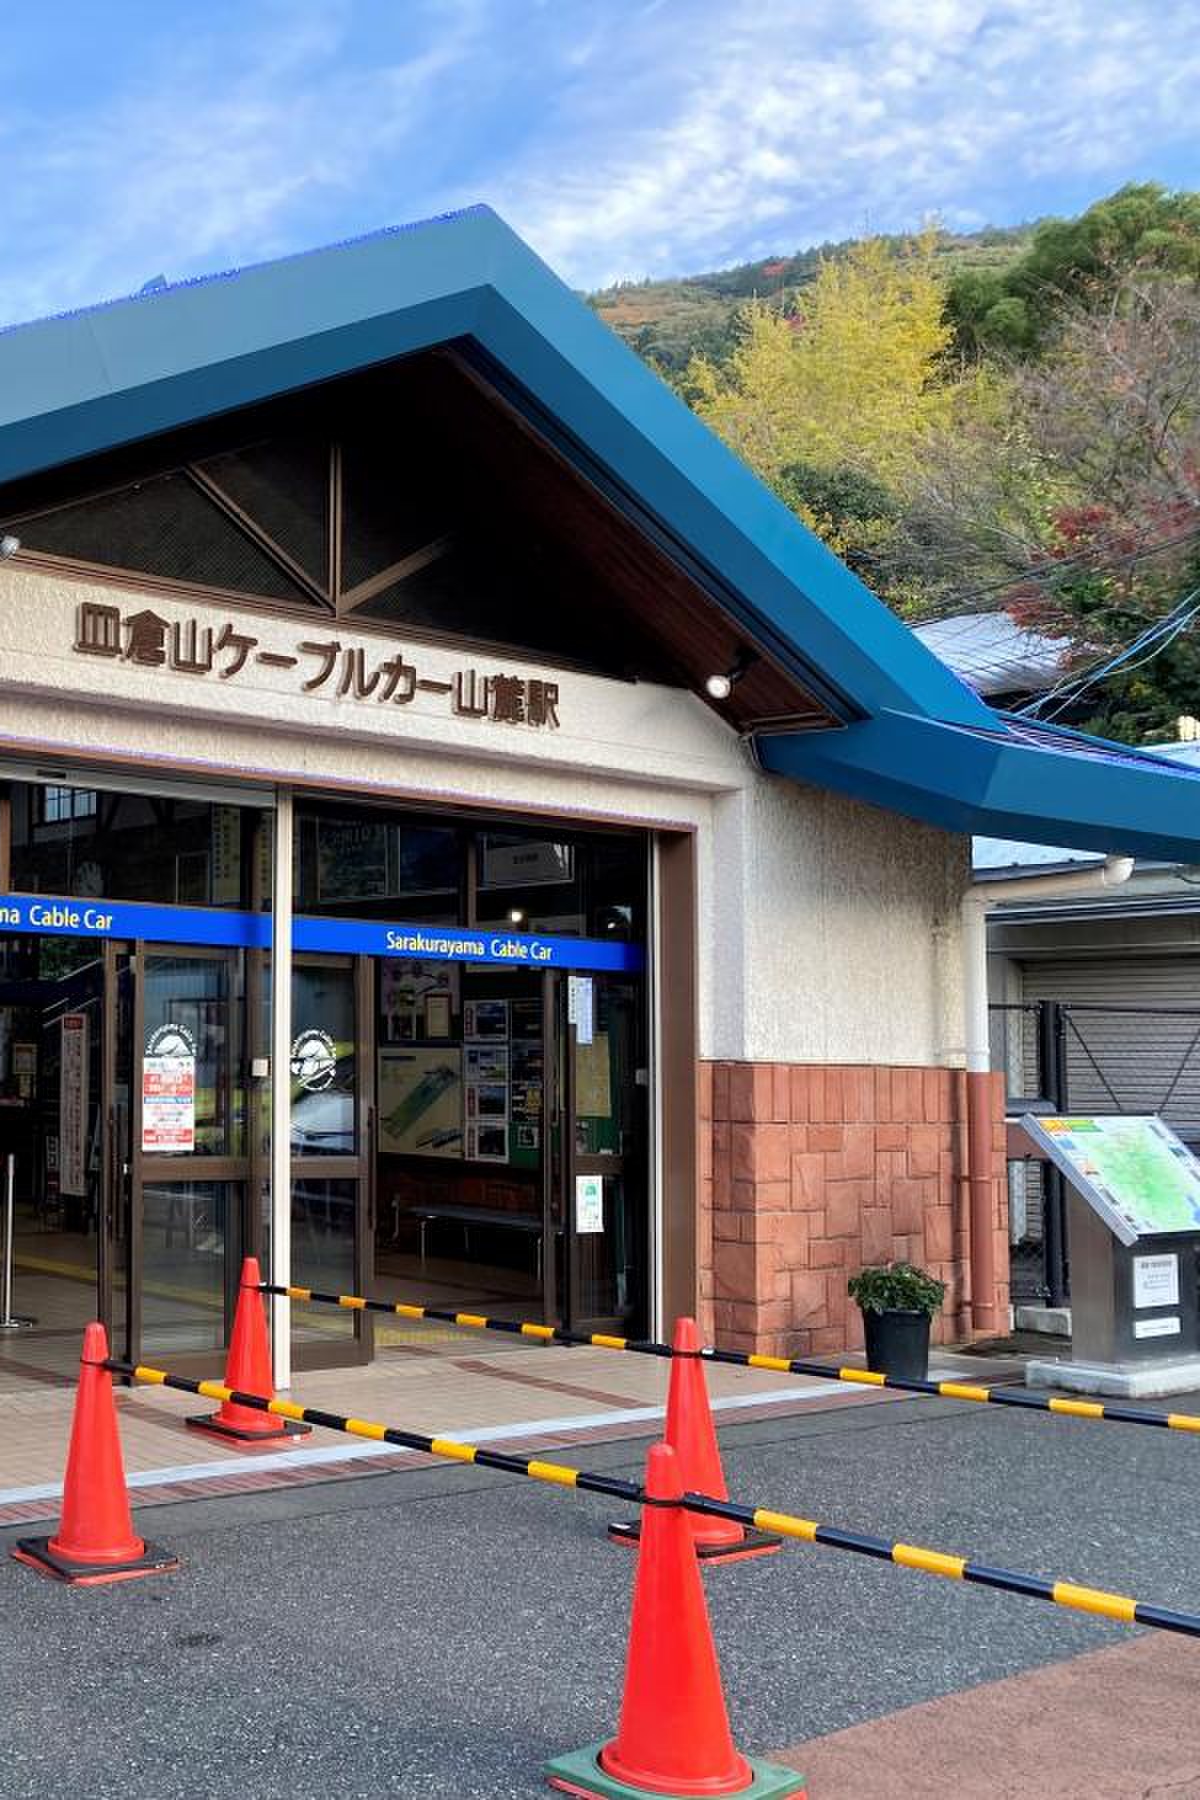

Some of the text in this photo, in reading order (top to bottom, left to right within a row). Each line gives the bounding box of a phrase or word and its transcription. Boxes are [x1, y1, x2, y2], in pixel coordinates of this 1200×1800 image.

[73, 601, 560, 729] 皿倉山ケーブルカー山麓駅
[29, 904, 80, 928] Cable
[84, 909, 113, 930] Car
[386, 931, 553, 960] Sarakurayama Cable Car
